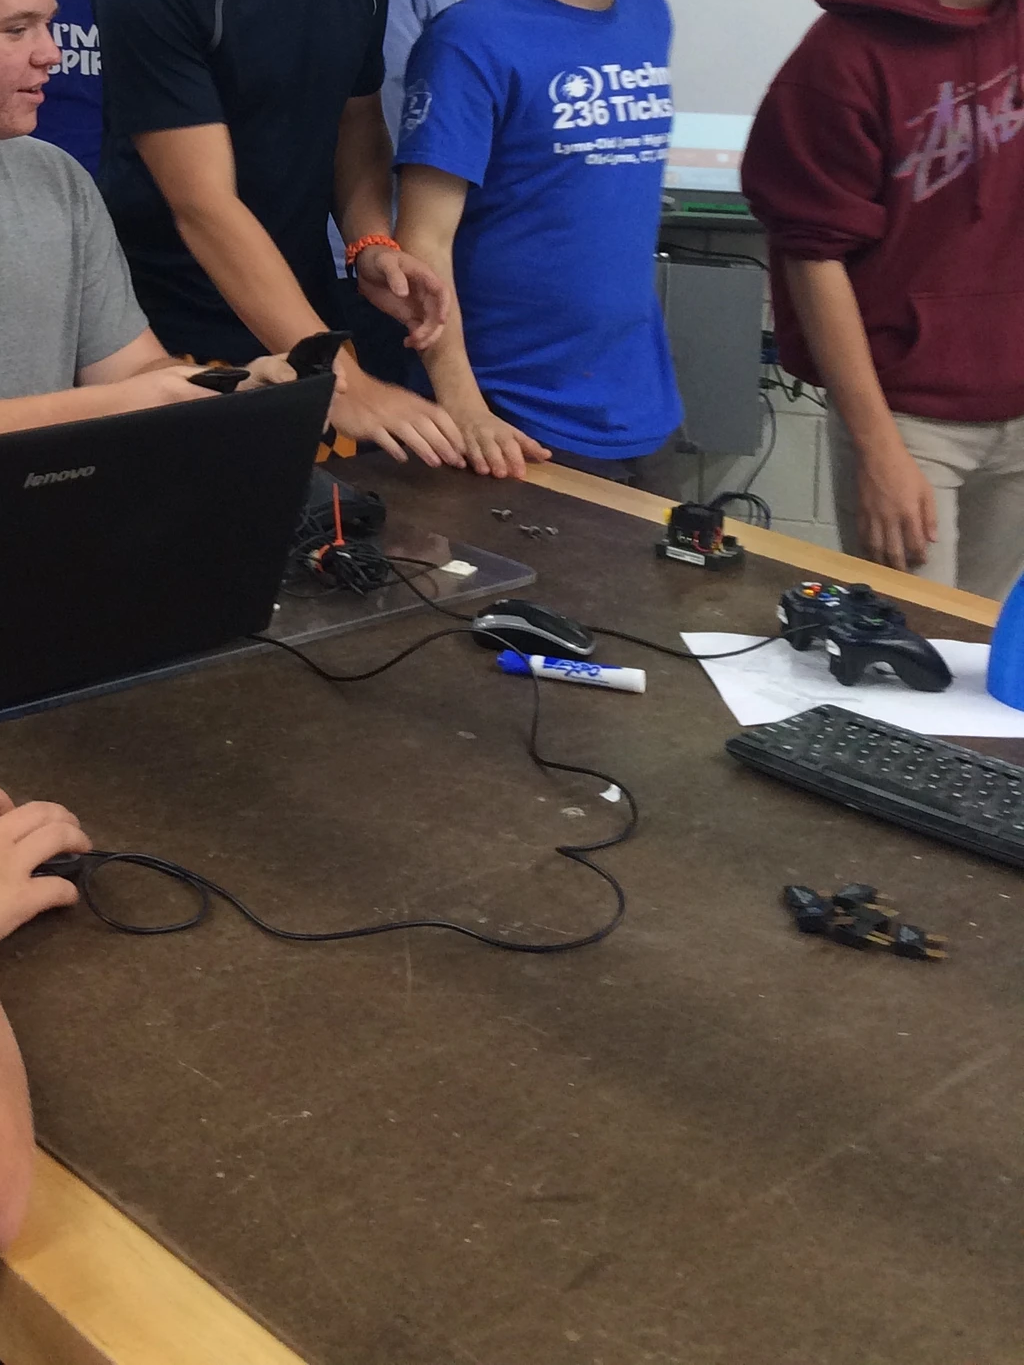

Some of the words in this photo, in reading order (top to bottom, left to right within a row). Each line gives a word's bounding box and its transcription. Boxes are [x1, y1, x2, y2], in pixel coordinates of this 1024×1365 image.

[53, 22, 100, 49] I'M
[553, 99, 610, 129] 236
[608, 93, 673, 122] Ticks
[24, 466, 96, 489] lenovo
